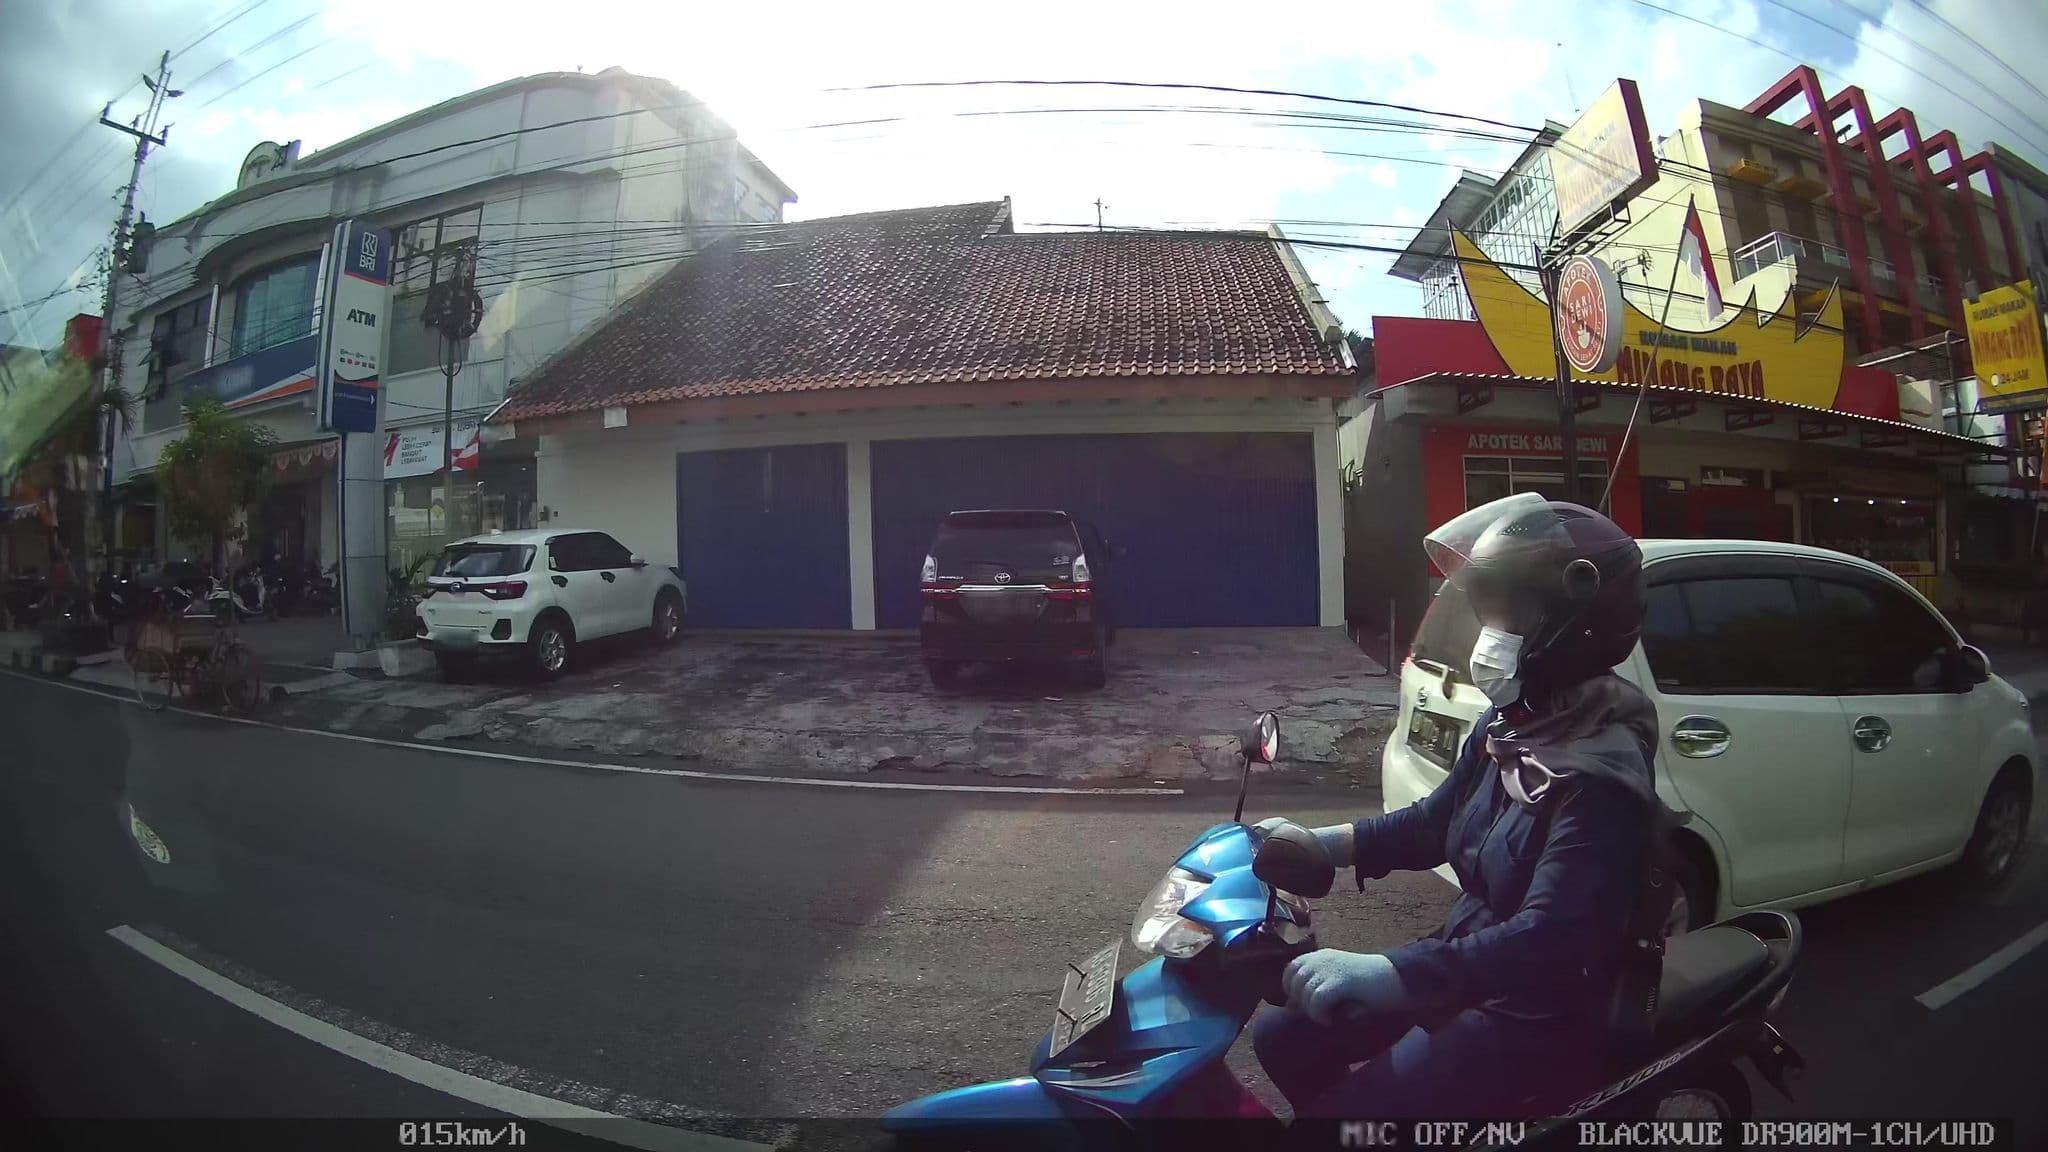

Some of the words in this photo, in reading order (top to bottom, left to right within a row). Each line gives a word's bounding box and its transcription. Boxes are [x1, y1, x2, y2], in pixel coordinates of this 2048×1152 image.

[360, 254, 376, 271] BRI
[1569, 292, 1591, 313] SARI
[346, 308, 376, 328] ATM
[1571, 304, 1593, 325] DEWI
[1467, 433, 1530, 450] APOTEK
[1533, 435, 1564, 450] SAR
